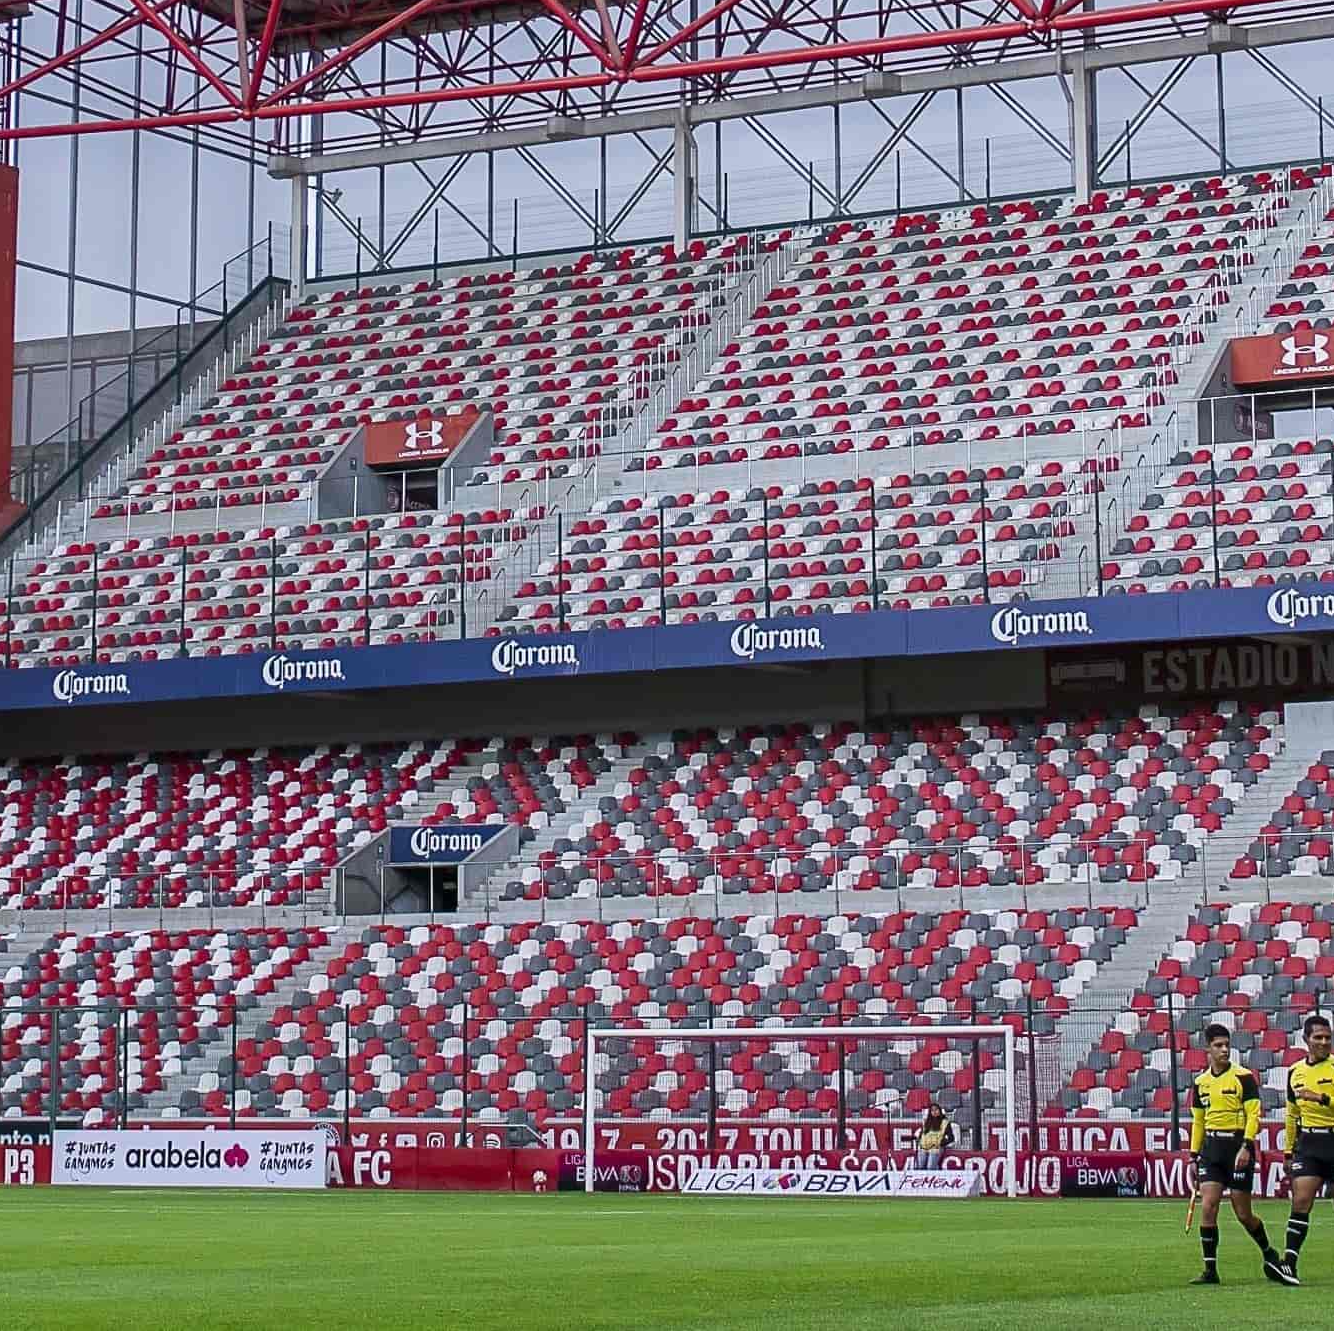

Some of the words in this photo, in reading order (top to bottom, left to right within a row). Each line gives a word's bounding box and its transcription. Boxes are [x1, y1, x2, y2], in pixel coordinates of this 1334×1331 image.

[730, 622, 824, 659] Corona
[990, 607, 1093, 645] Corona
[263, 655, 346, 689] Corona
[491, 639, 580, 675] Corona
[1141, 644, 1298, 693] ESTADIO
[54, 670, 131, 704] Corona
[411, 827, 482, 858] Corona
[4, 1148, 35, 1185] P3
[64, 1155, 115, 1170] GANAMOS
[125, 1141, 221, 1169] arabela
[259, 1155, 313, 1171] GANAMOS
[353, 1150, 392, 1186] FC
[1067, 1157, 1090, 1167] LIGA
[687, 1172, 756, 1191] LIGA
[803, 1174, 891, 1193] BBVA
[1078, 1169, 1118, 1185] BBVA
